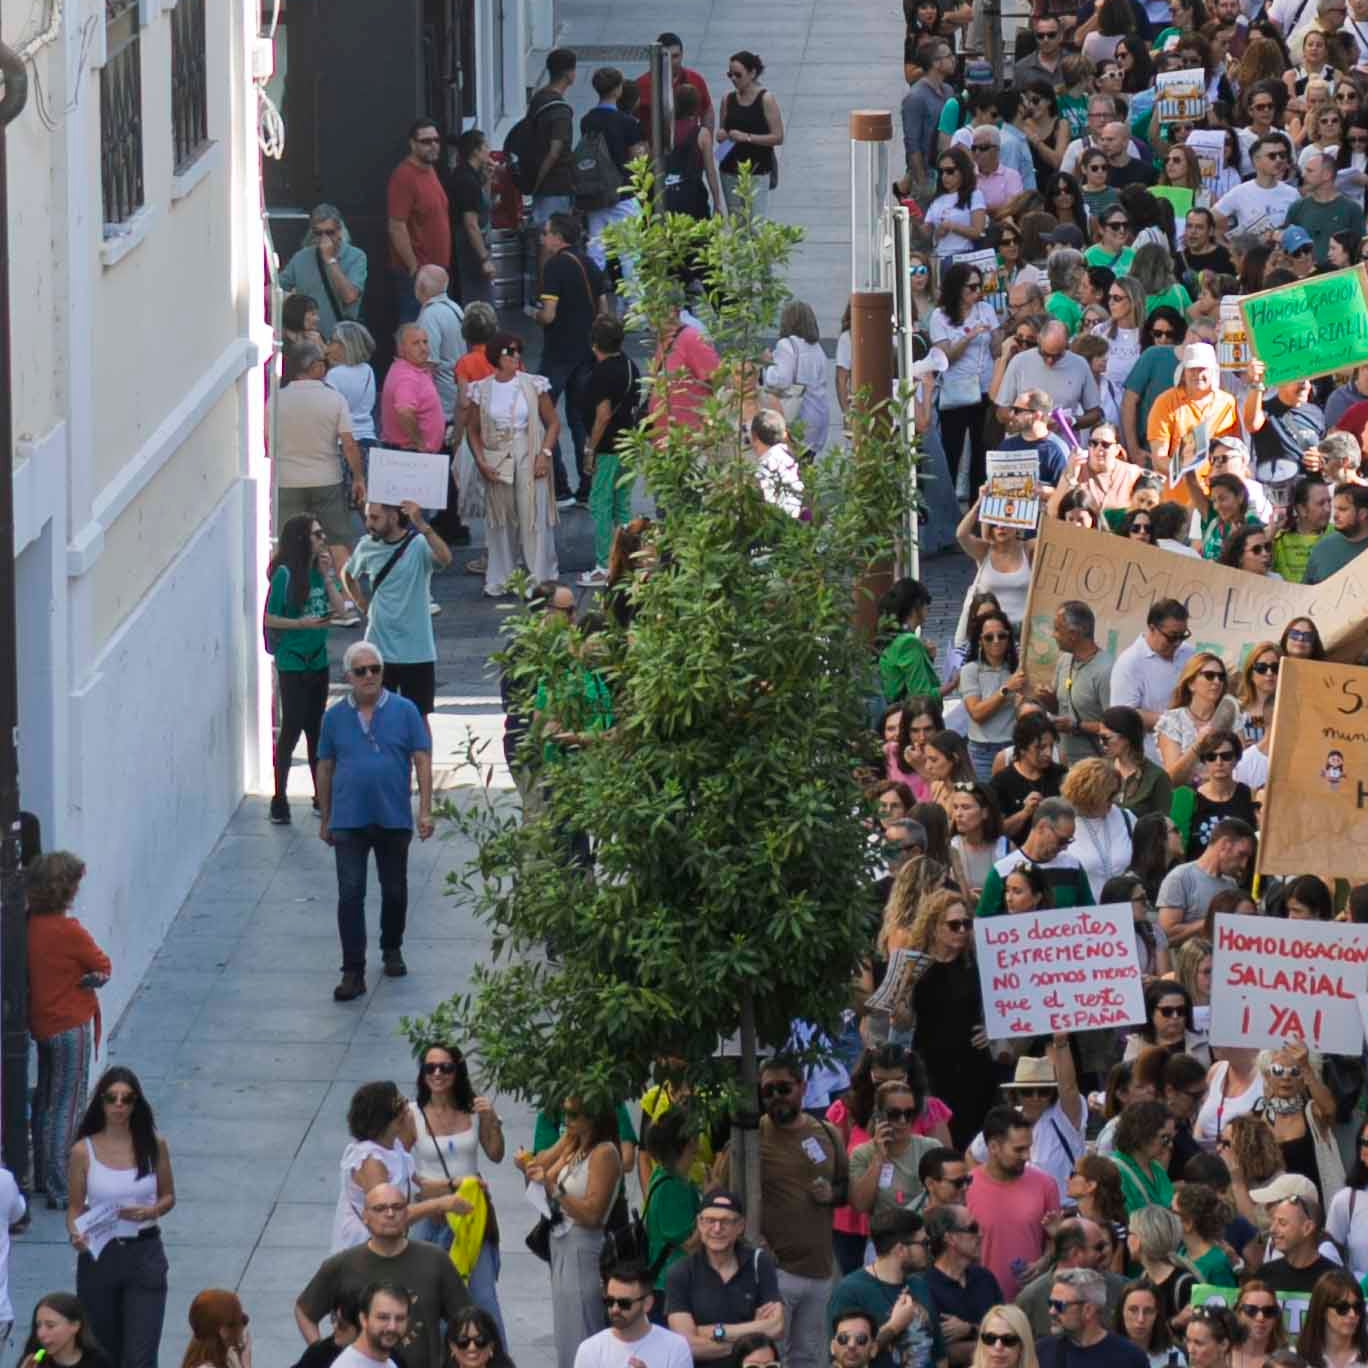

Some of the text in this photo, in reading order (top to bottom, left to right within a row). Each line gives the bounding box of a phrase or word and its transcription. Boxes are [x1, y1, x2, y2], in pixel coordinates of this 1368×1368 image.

[1027, 912, 1117, 941] docentes
[992, 965, 1138, 991] NO somos menos
[994, 987, 1125, 1017] que el resto
[1009, 1007, 1130, 1032] de ESPAÑA
